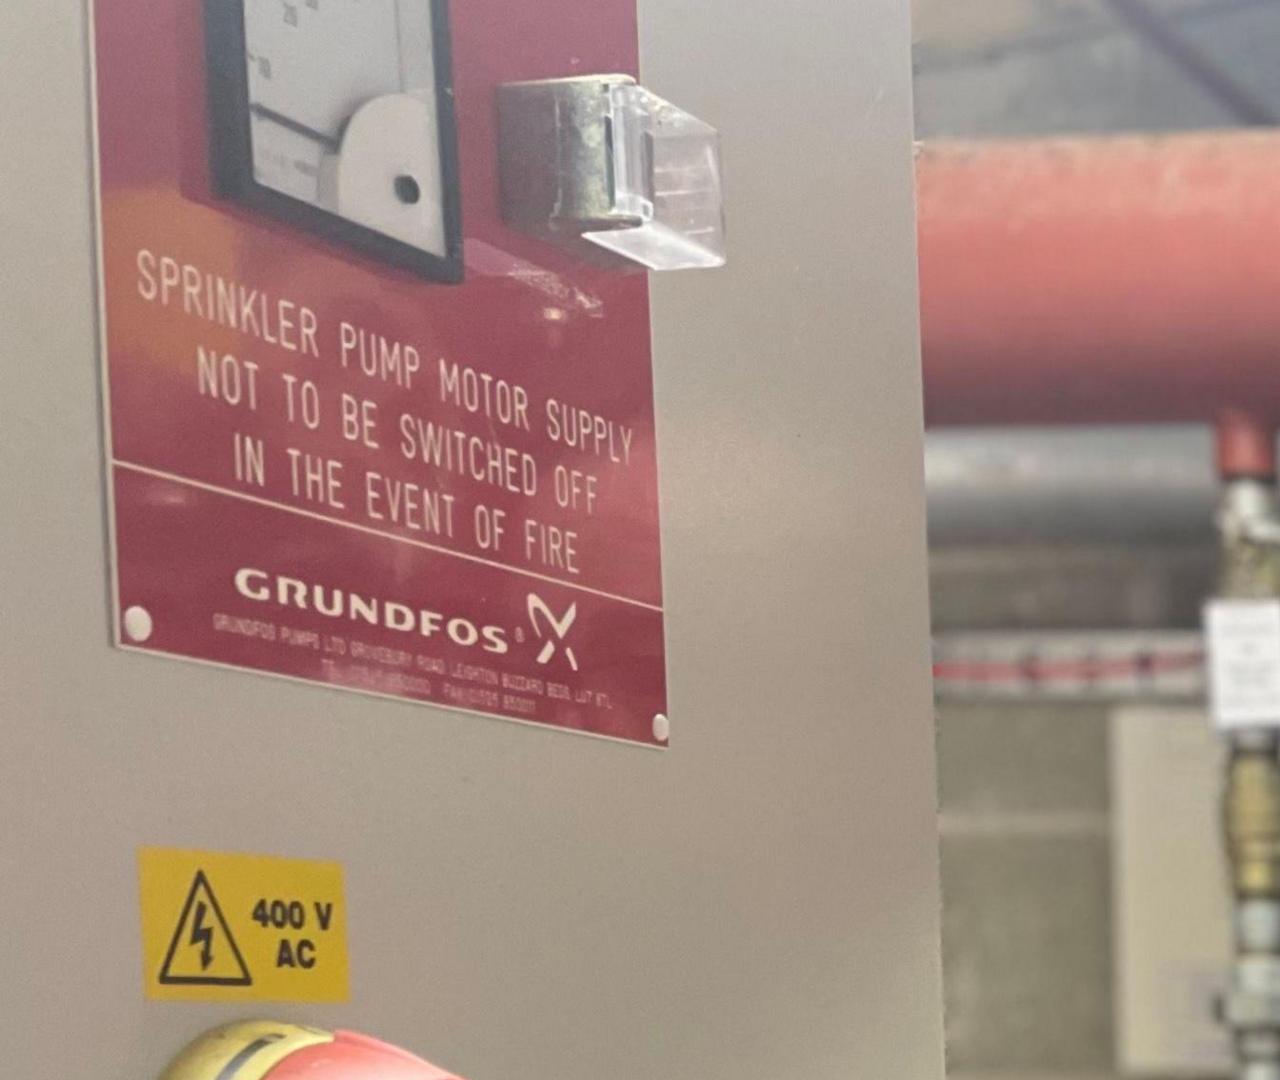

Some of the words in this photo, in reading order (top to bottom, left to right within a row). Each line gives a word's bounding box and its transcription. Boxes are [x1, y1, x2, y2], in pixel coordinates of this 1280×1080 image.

[136, 249, 320, 358] SPRINKLER
[340, 321, 421, 390] PUMP
[438, 358, 531, 431] MOTOR
[545, 398, 634, 467] SUPPLY
[197, 346, 260, 410] NOT
[282, 373, 321, 430] TO
[341, 392, 380, 450] BE
[399, 413, 538, 497] SWITCHED
[554, 464, 599, 515] OFF
[234, 432, 265, 488] IN
[286, 447, 345, 509] THE
[365, 471, 455, 538] EVENT
[474, 504, 506, 552] OF
[524, 518, 581, 574] FIRE
[234, 567, 509, 655] GRUNDFOS
[252, 898, 306, 930] 400
[313, 901, 333, 931] V
[276, 938, 316, 970] AC
